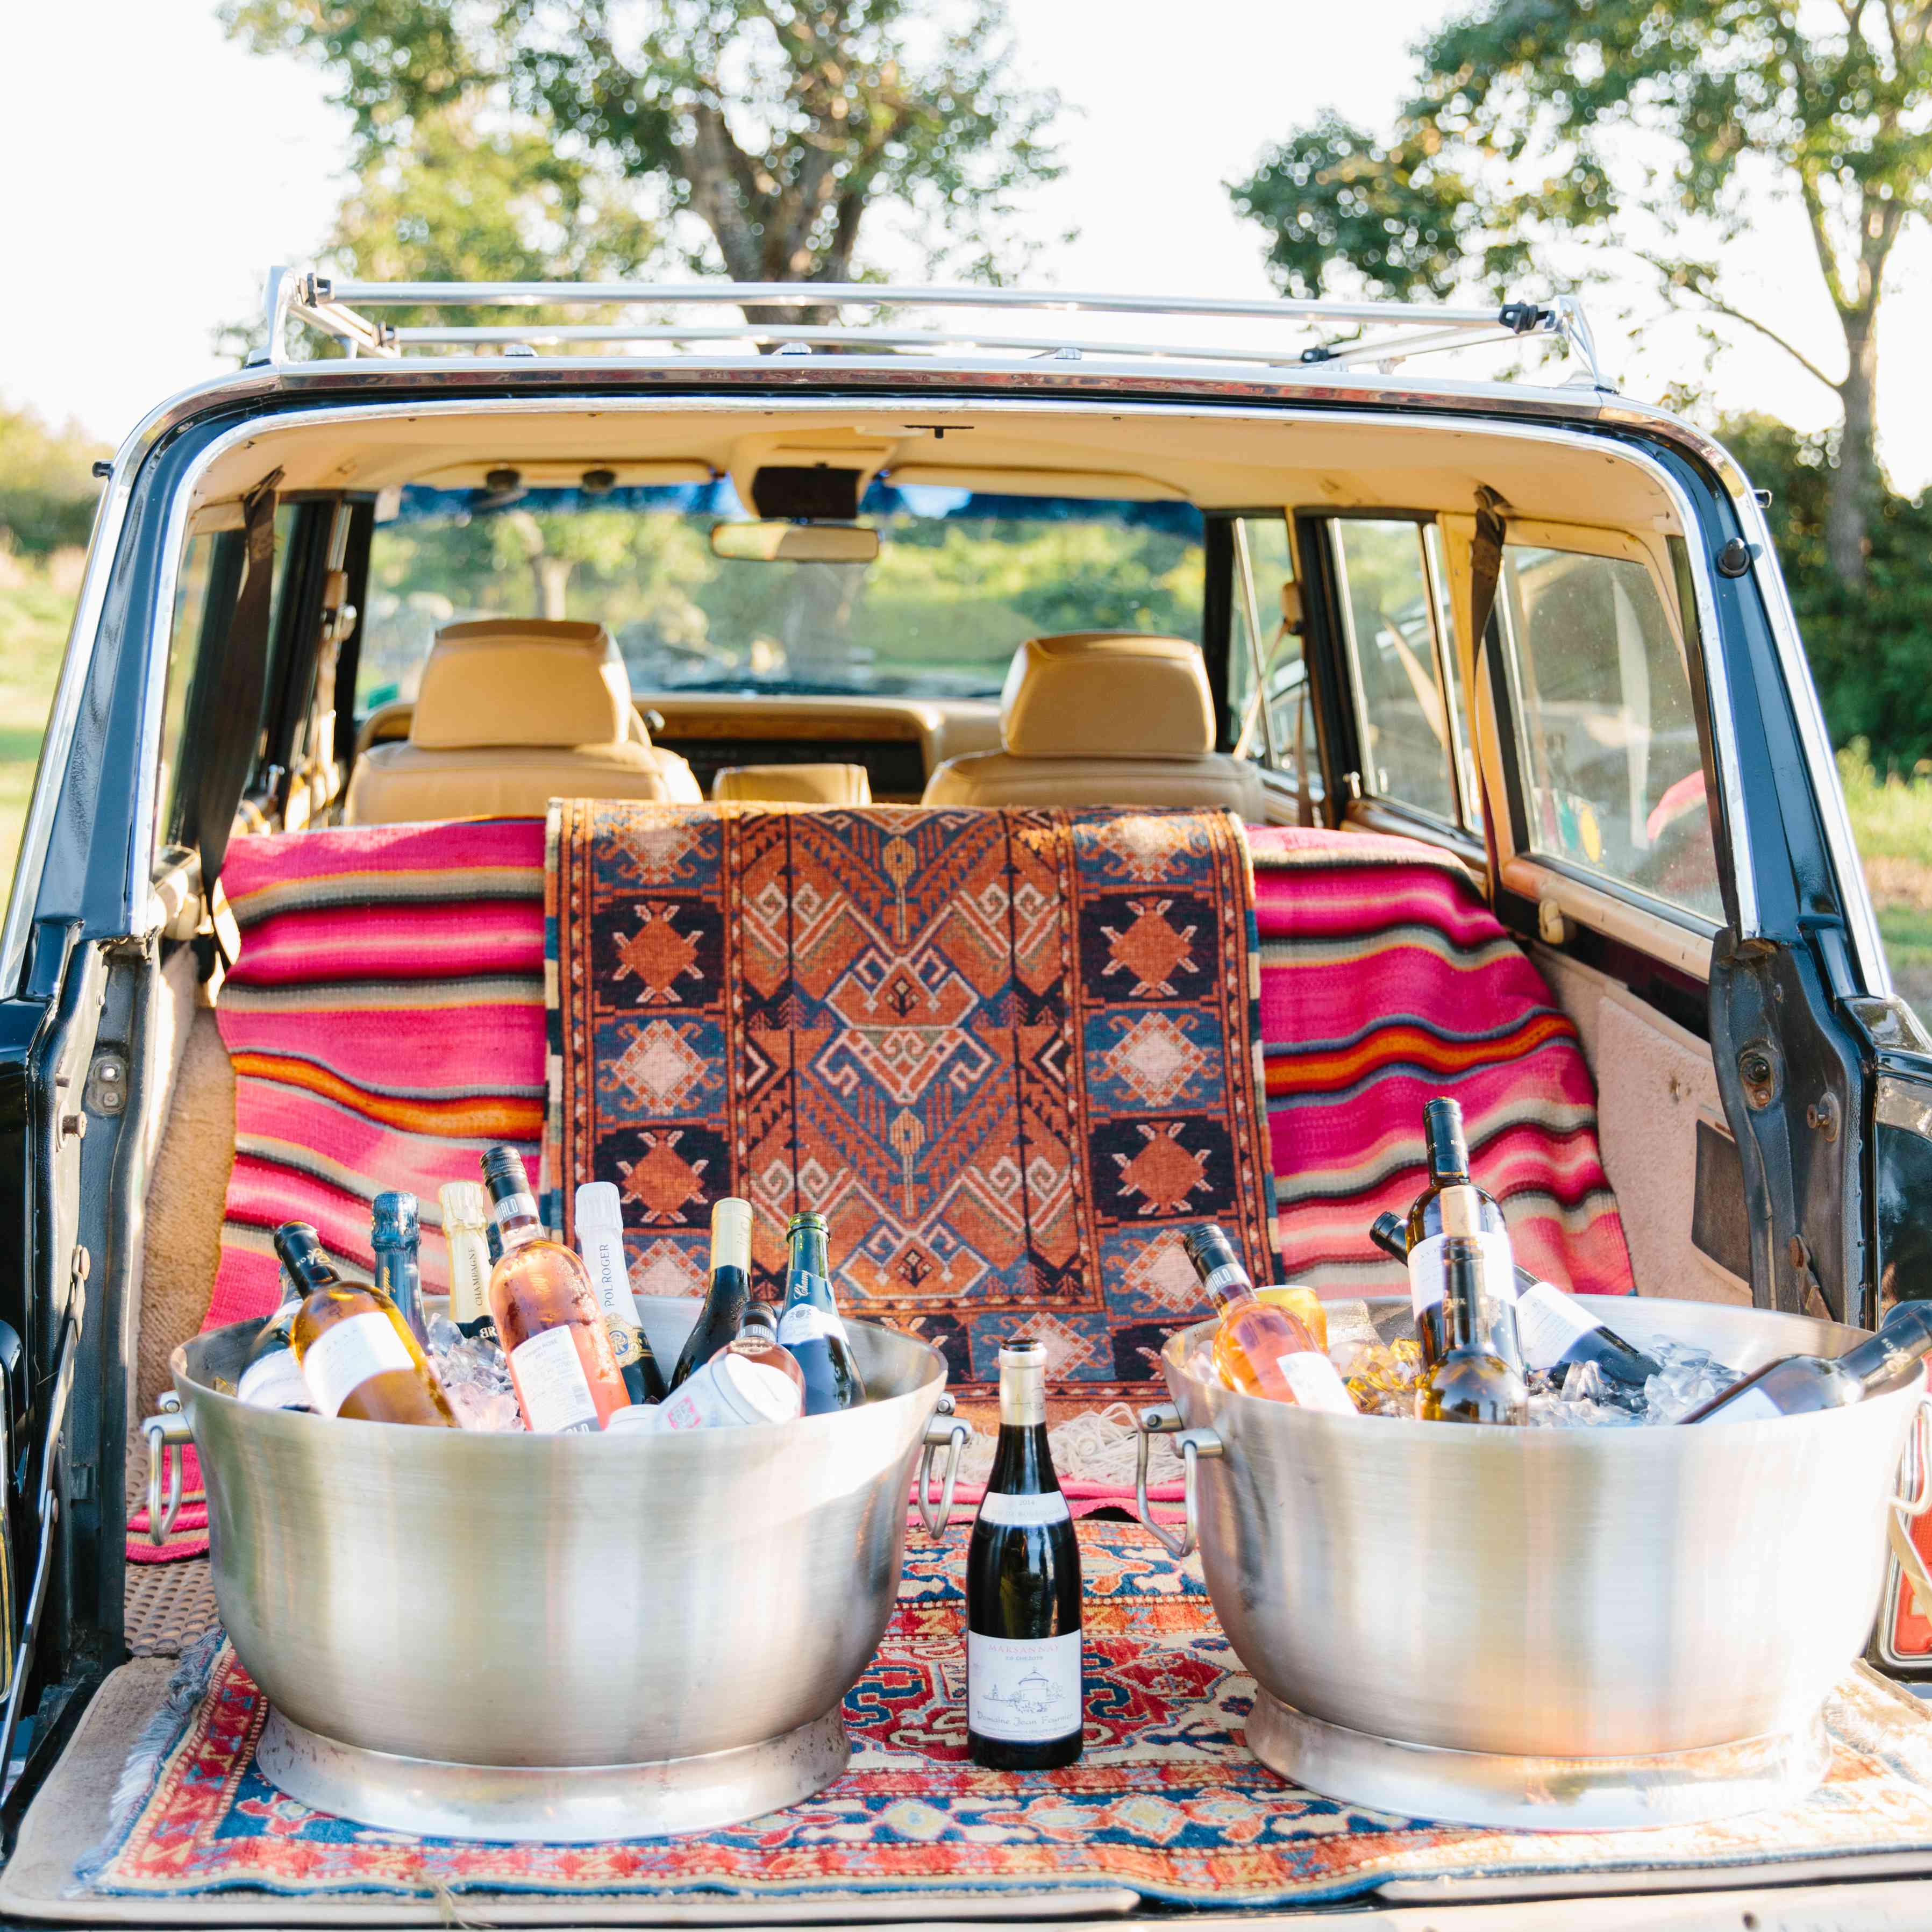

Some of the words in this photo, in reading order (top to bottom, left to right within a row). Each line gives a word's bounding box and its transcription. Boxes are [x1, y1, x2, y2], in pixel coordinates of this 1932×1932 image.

[599, 1244, 612, 1284] ROGER
[469, 1247, 483, 1307] CHAMPAGNE
[604, 1285, 615, 1308] POL
[988, 1644, 1059, 1653] MARSANNAY
[976, 1710, 1011, 1725] Domaine
[1014, 1716, 1037, 1727] Jean
[1041, 1712, 1074, 1724] Fournier
